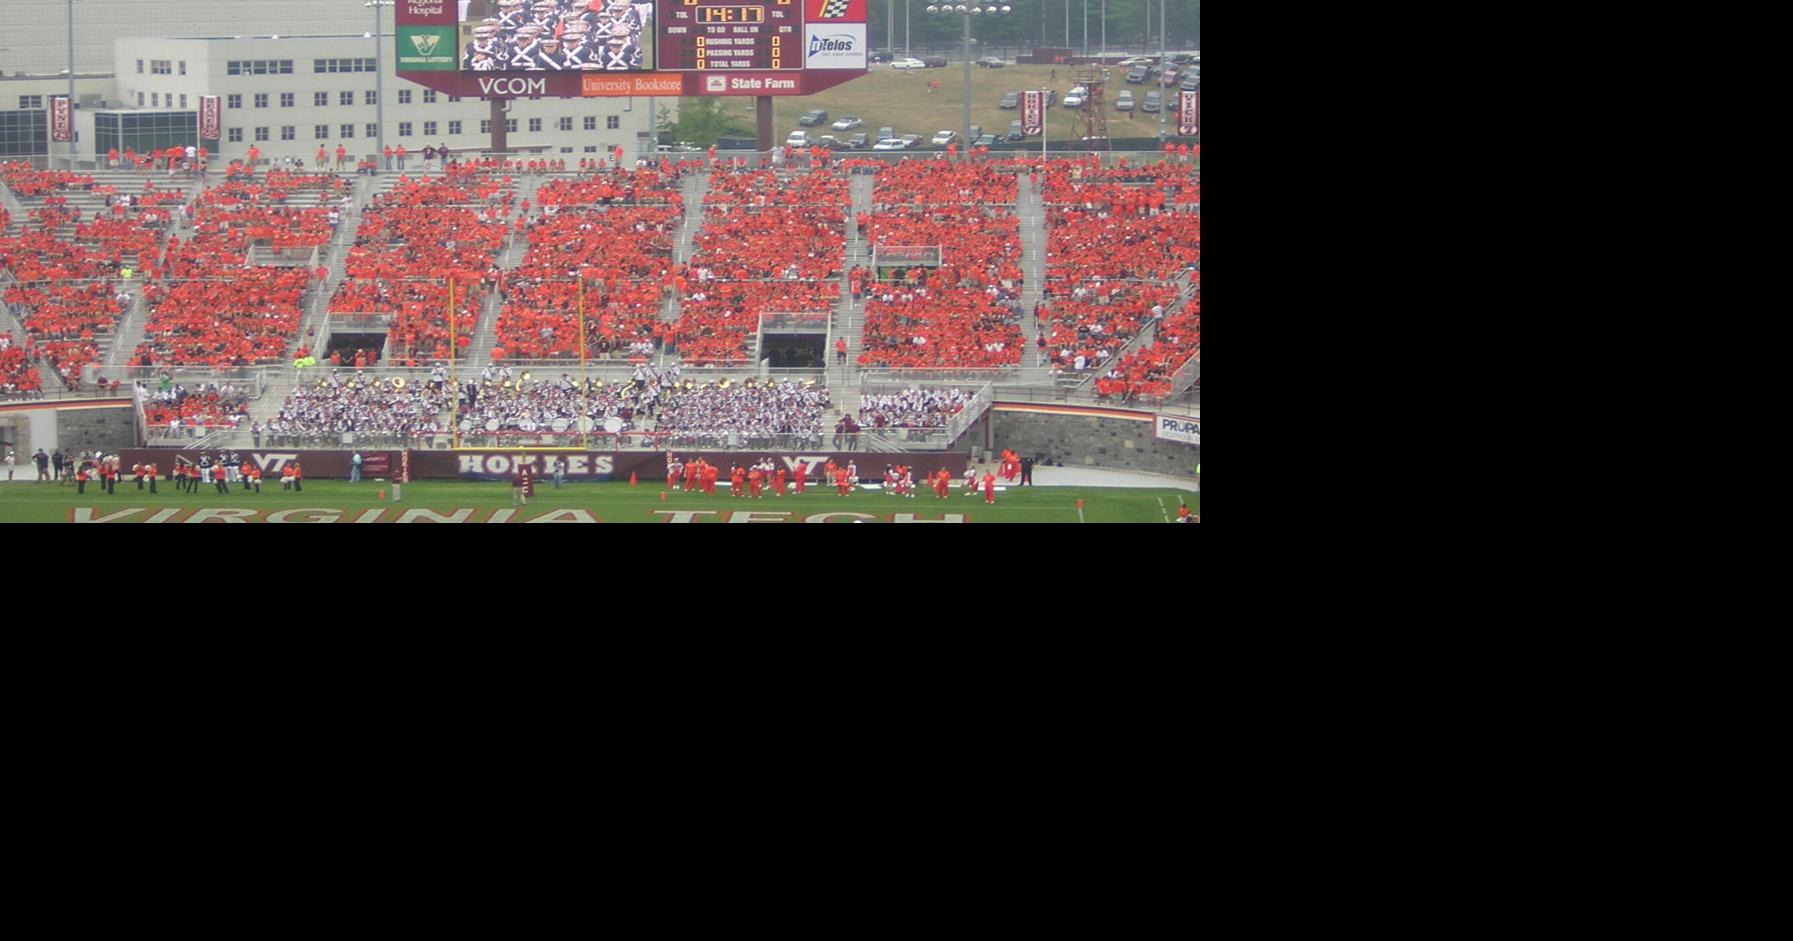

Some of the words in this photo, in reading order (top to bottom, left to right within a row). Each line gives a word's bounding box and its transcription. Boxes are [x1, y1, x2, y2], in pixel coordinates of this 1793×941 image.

[409, 6, 442, 16] Hospital
[705, 7, 762, 21] 14:17
[478, 78, 546, 94] VCOM
[583, 78, 631, 93] University
[635, 77, 682, 90] Bookstore
[731, 78, 761, 89] State
[765, 79, 795, 89] Farm
[1184, 95, 1193, 123] VICK
[202, 129, 218, 138] 25
[252, 454, 298, 472] VT
[458, 455, 614, 474] HOKIES
[73, 508, 600, 523] VIRGINIA
